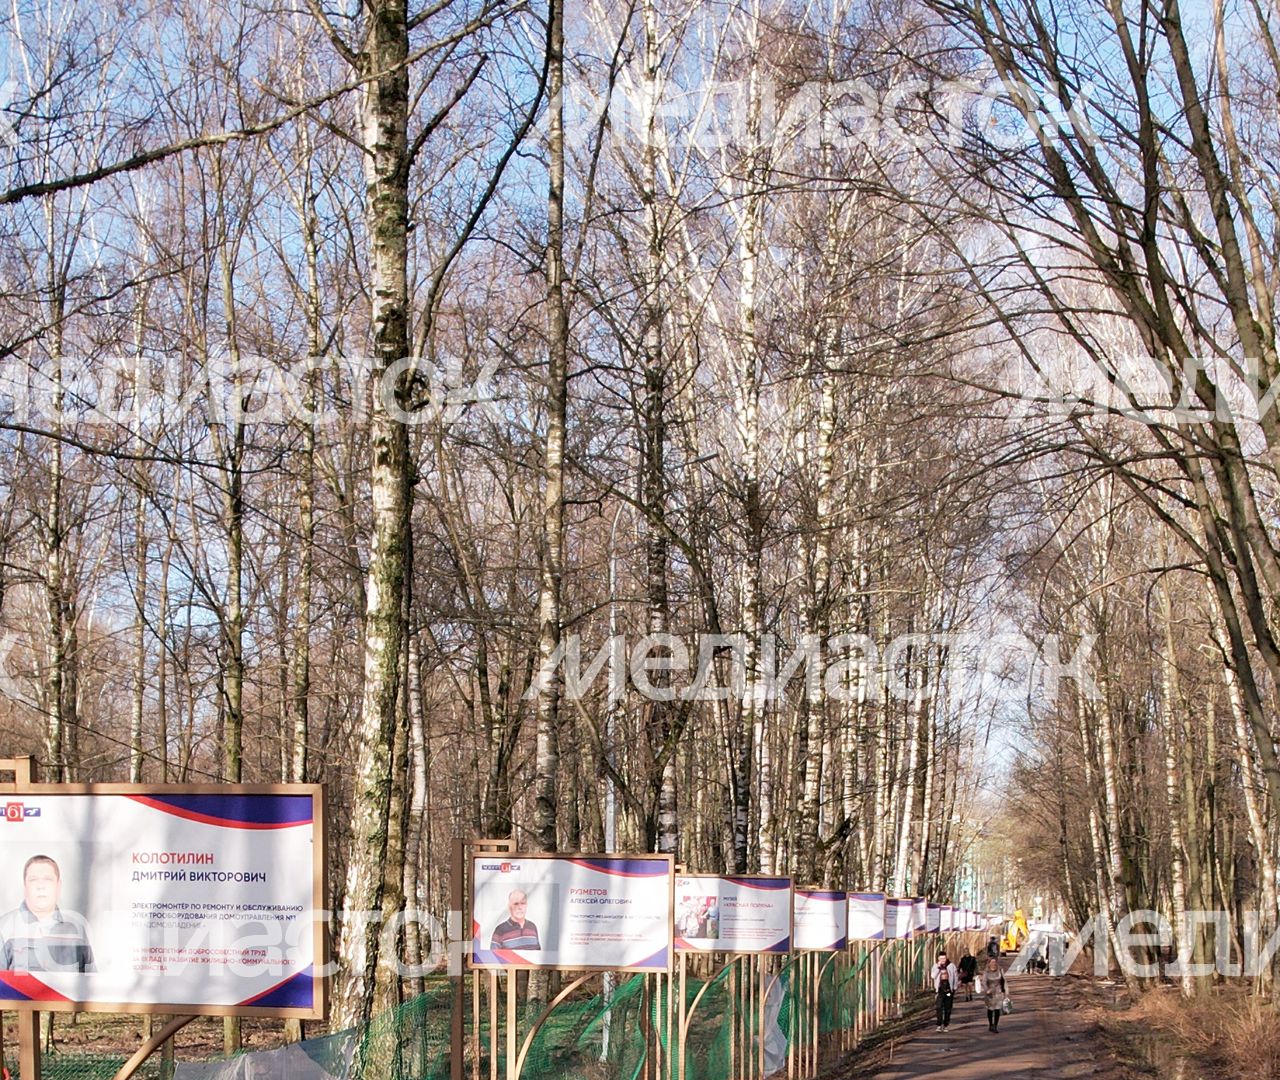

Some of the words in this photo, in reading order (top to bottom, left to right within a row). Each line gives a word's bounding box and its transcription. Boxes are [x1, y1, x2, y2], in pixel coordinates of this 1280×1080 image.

[6, 804, 24, 819] 61
[132, 852, 214, 865] КОЛОТИЛИН
[132, 869, 186, 882] ДМИТРИЙ
[189, 871, 267, 883] ВИКТОРОВИЧ
[190, 902, 202, 910] ПО
[202, 903, 234, 911] РЕМОНТУ
[242, 903, 304, 912] ОБСЛУЖИВАНИЮ
